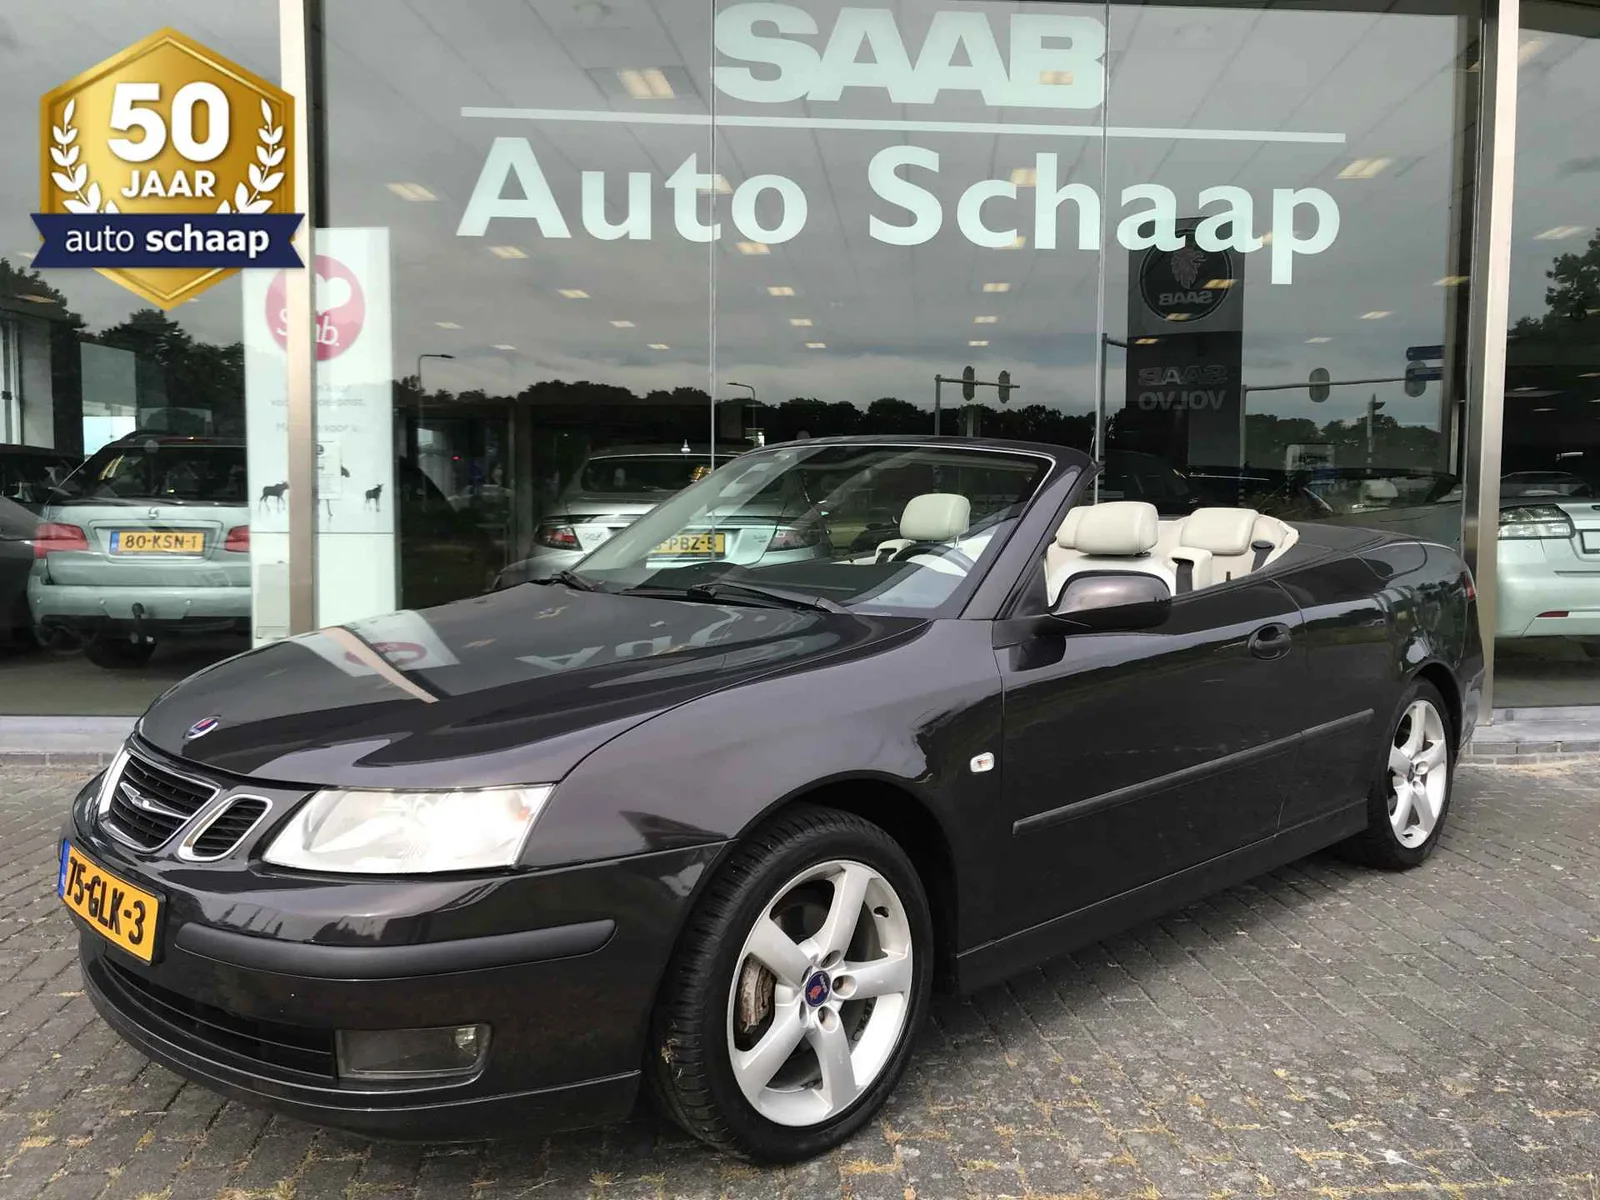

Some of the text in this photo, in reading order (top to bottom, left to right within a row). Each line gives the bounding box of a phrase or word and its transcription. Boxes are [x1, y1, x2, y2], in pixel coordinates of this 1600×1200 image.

[714, 2, 1106, 109] SAAB
[456, 137, 1340, 285] Auto Schaap
[67, 857, 146, 945] 75-GLK-3
